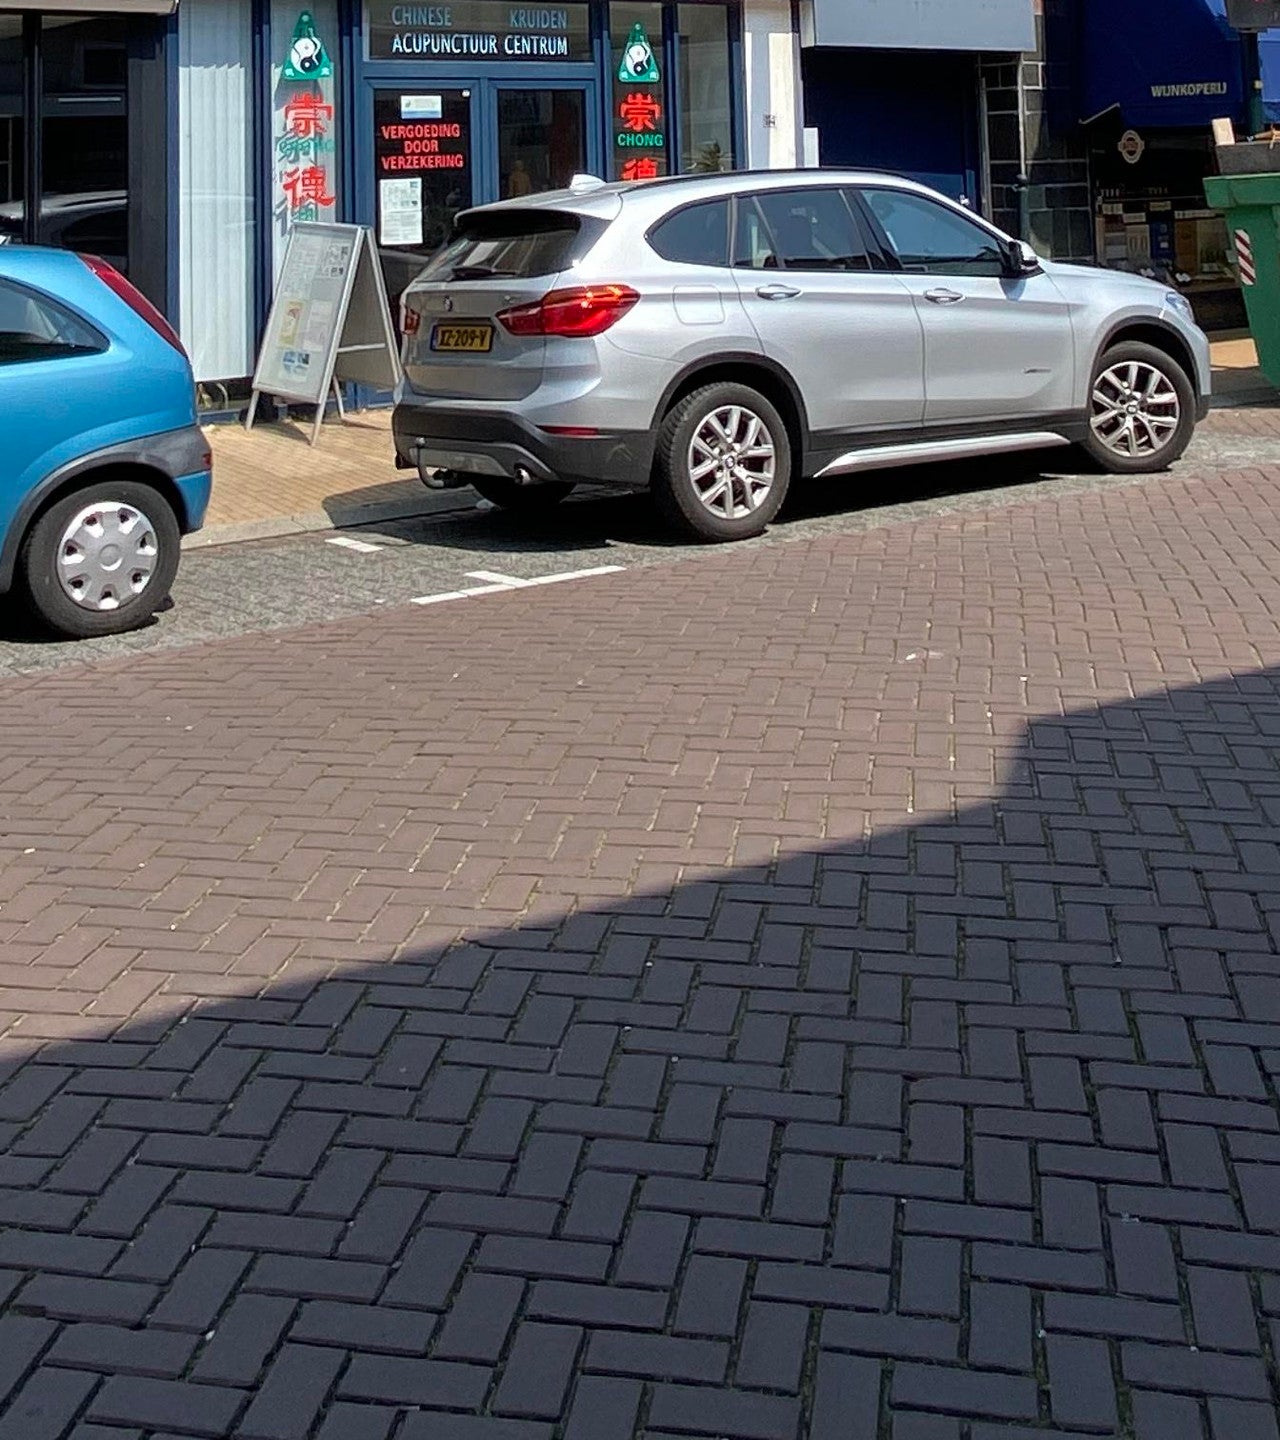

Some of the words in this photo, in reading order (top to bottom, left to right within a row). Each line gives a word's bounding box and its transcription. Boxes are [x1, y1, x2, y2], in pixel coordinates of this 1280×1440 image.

[391, 5, 452, 27] CHINESE
[509, 9, 568, 29] KRUIDEN
[392, 32, 498, 54] ACUPUNCTUUR
[504, 35, 568, 56] CENTRUM
[381, 123, 460, 140] VERGOEDING
[403, 140, 438, 154] DOOR
[617, 133, 664, 147] CHONG
[381, 154, 464, 170] VERZEKERING
